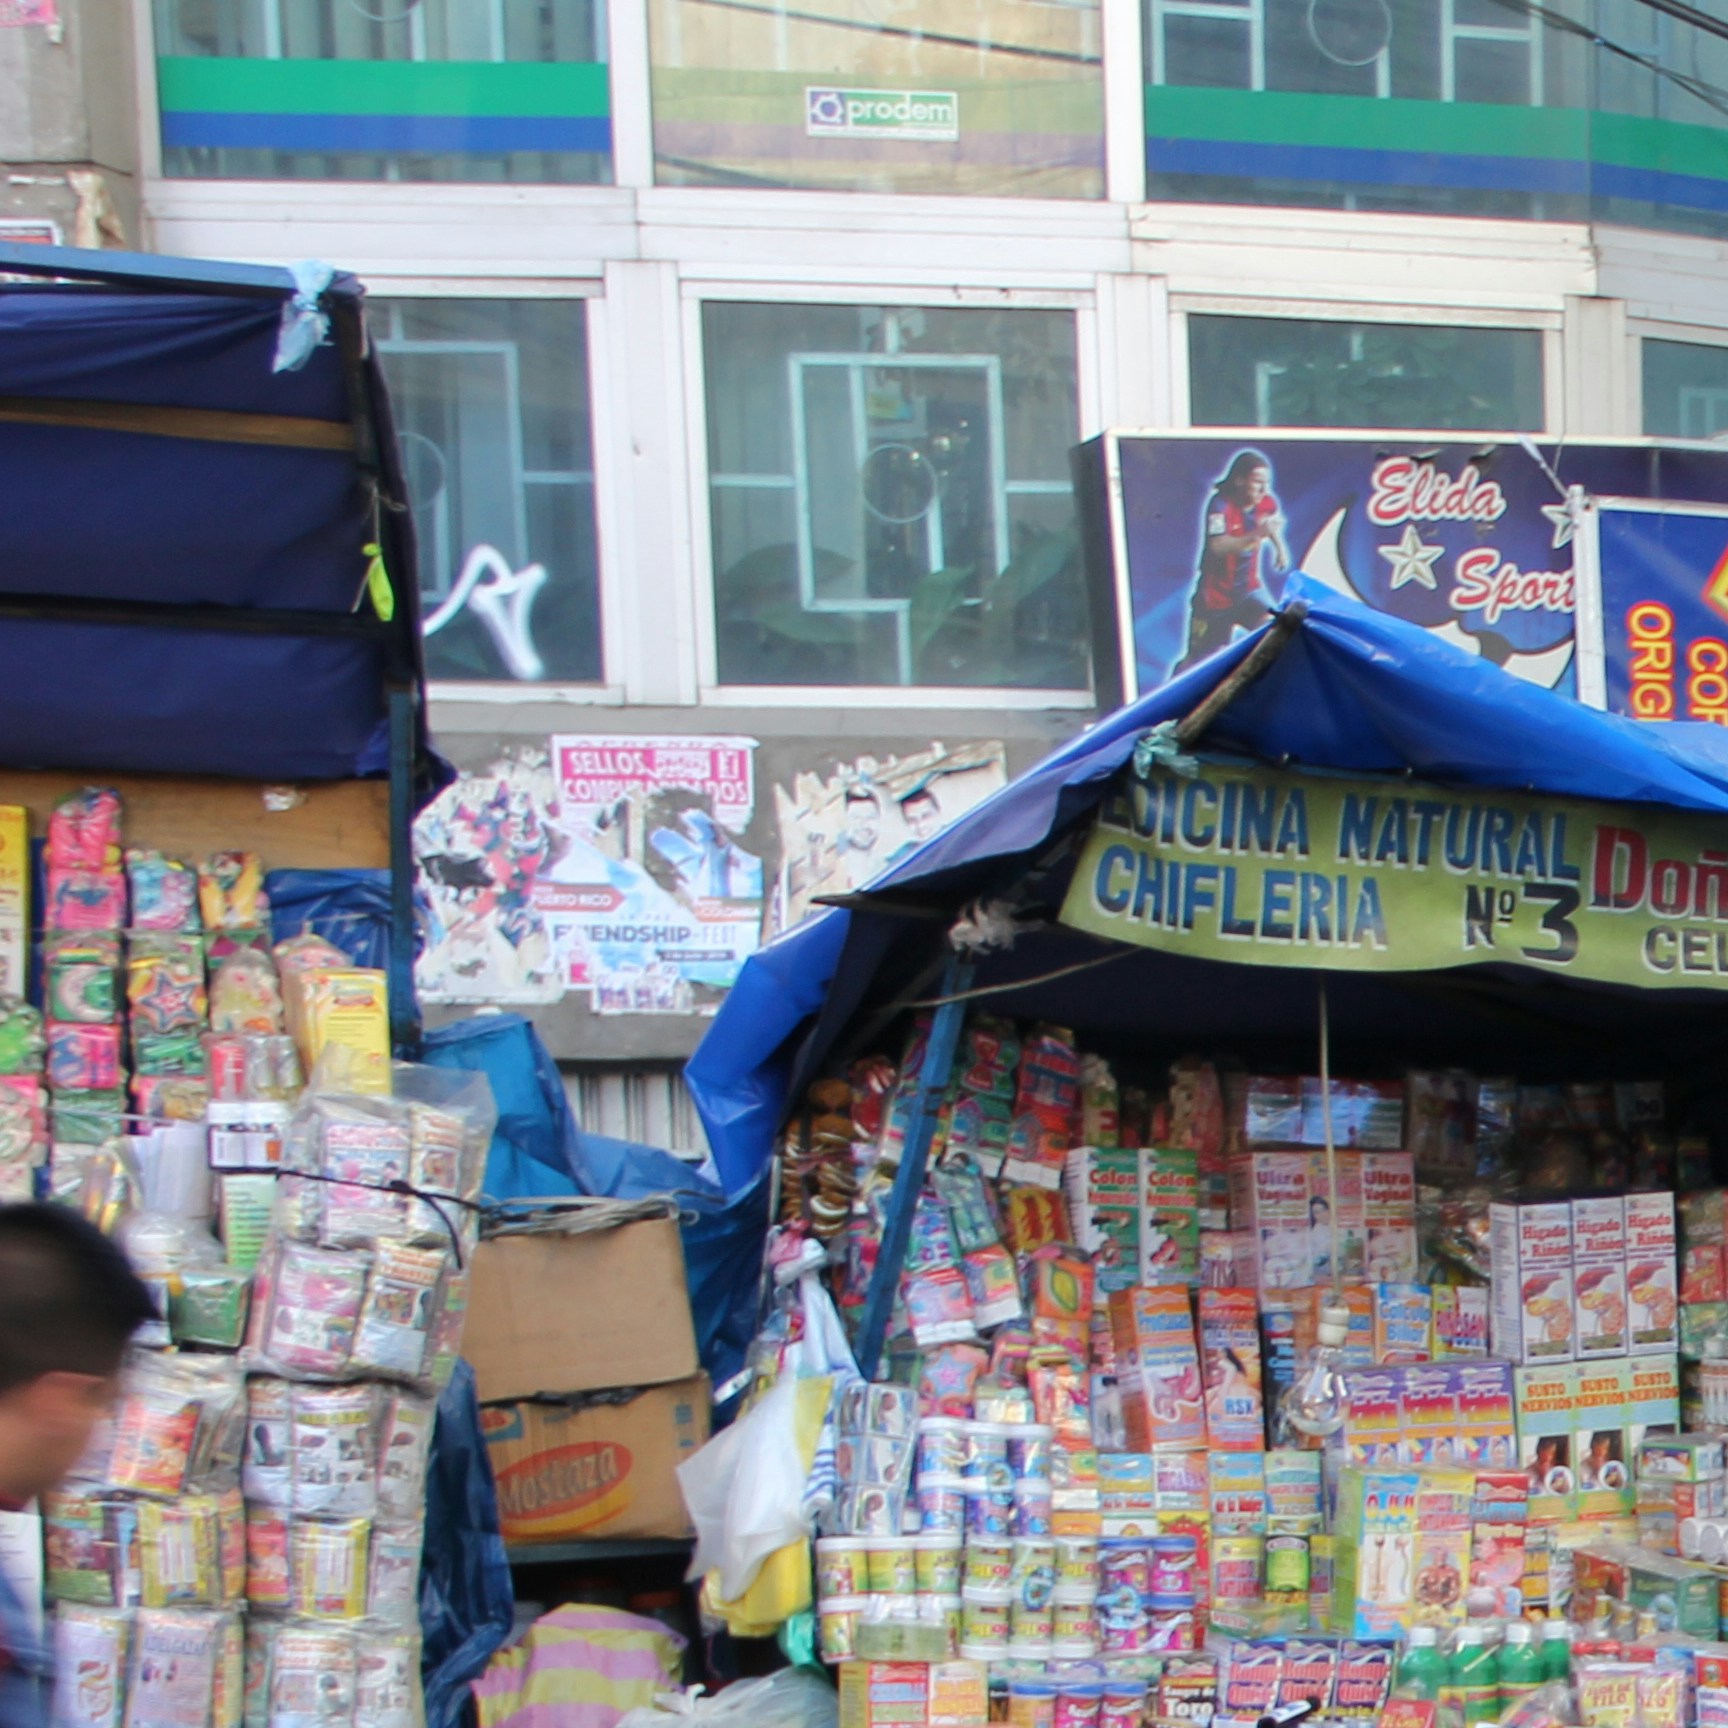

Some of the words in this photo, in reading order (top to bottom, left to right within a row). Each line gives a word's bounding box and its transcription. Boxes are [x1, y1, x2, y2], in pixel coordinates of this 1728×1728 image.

[848, 93, 952, 126] prodem
[1367, 455, 1507, 527] Elida
[570, 750, 643, 775] SELLOS
[1102, 778, 1310, 861] EDICINA
[1335, 793, 1581, 885] NATURAL
[1092, 844, 1389, 951] CHIFLERIA
[1519, 881, 1582, 966] 3
[1165, 1698, 1215, 1719] Toro
